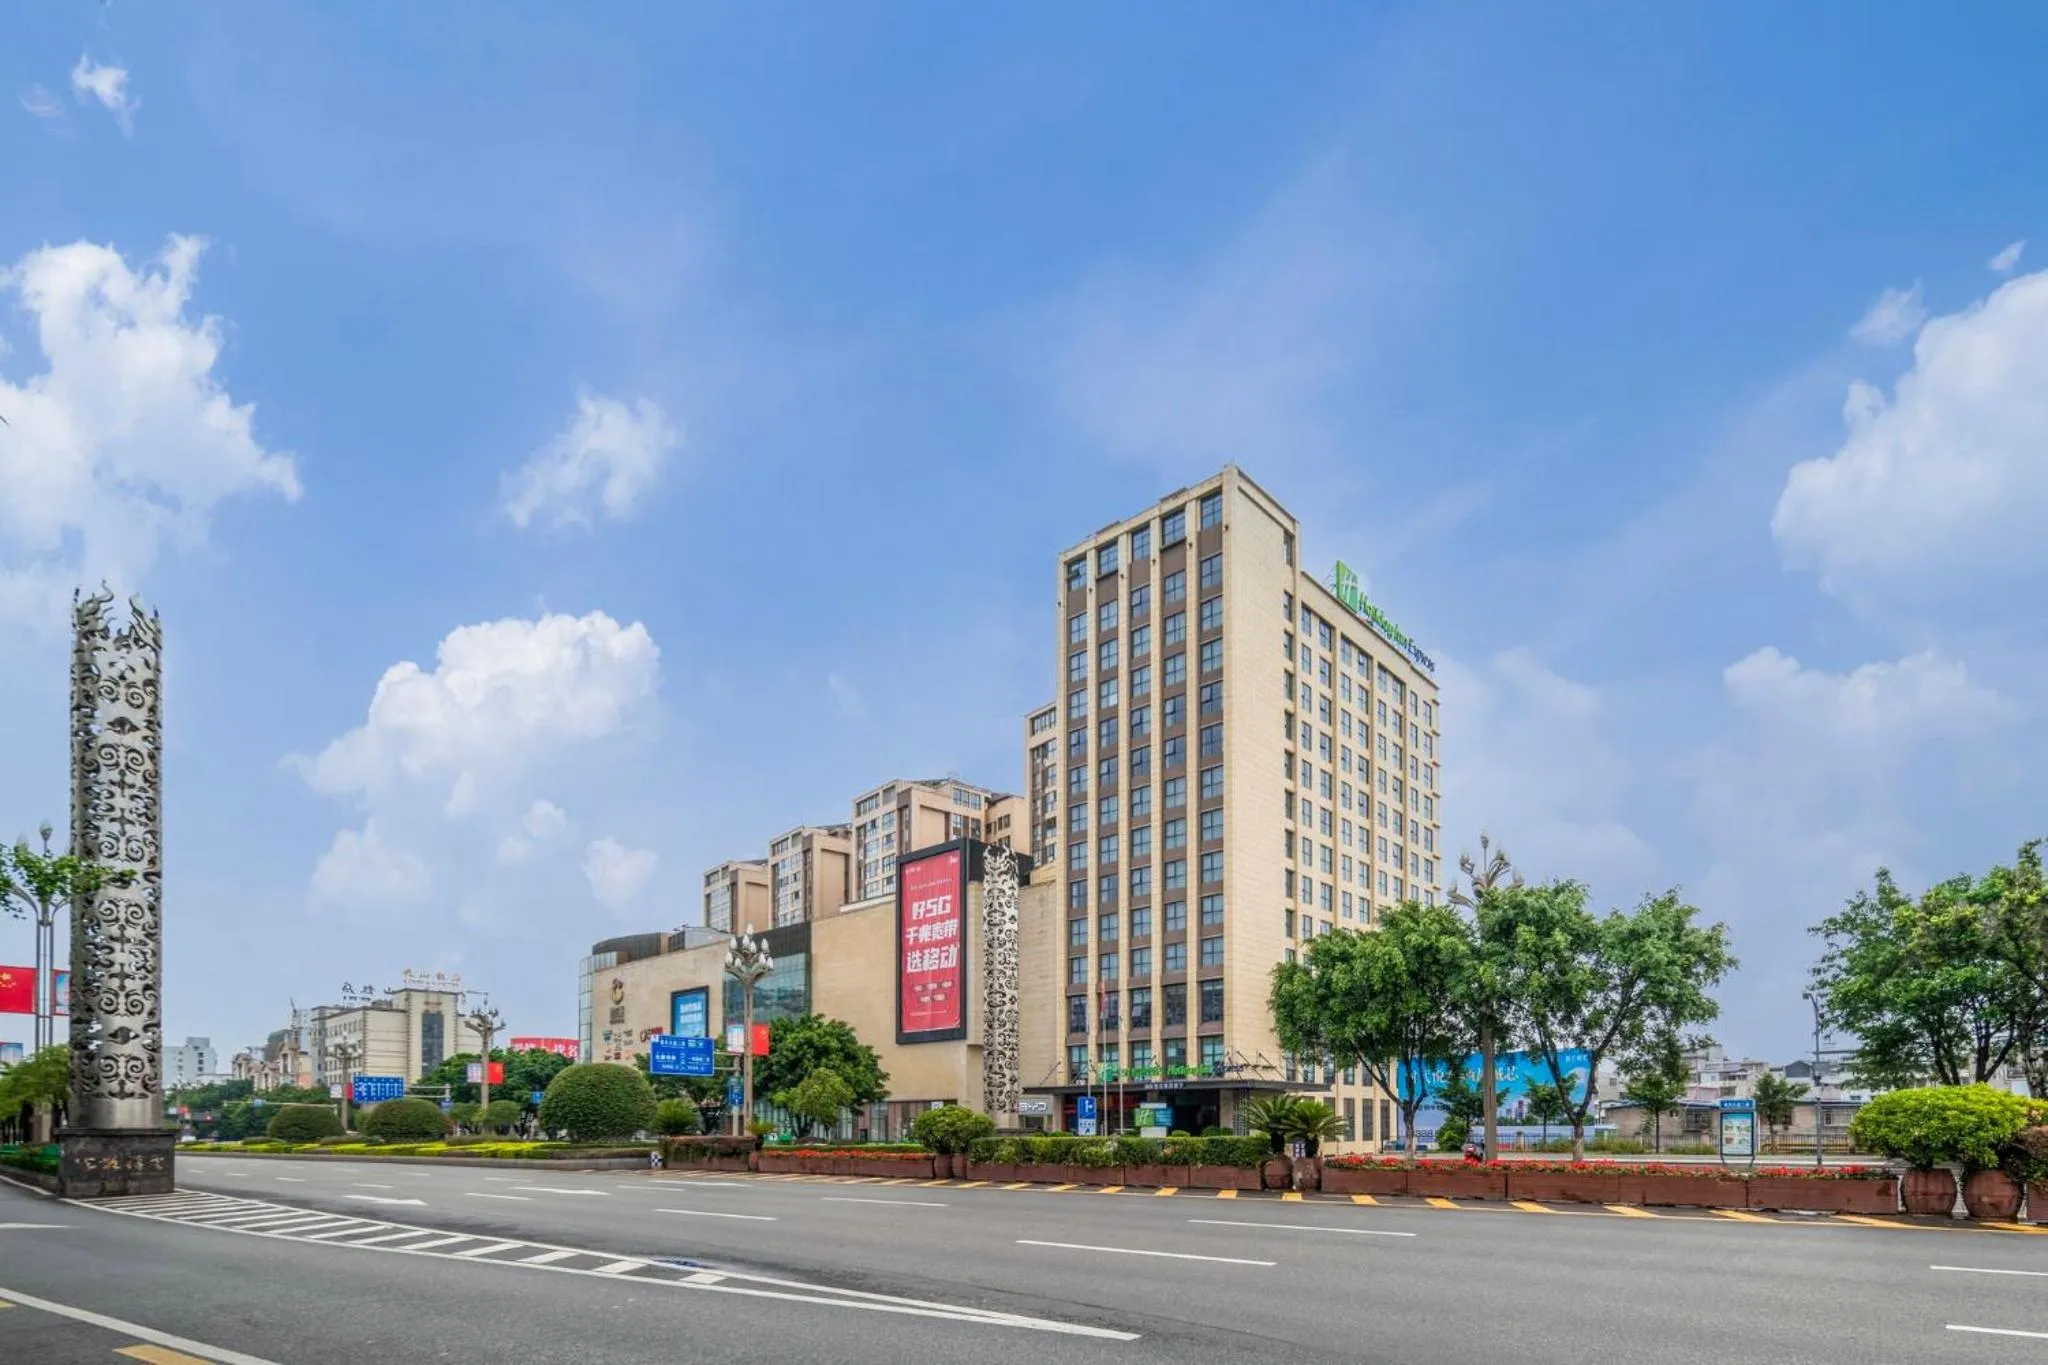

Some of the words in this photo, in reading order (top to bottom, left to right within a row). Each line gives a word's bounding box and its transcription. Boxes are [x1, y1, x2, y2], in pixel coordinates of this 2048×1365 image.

[912, 896, 952, 920] 好5G
[905, 919, 958, 945] 千兆宽带
[906, 945, 957, 973] 选移动
